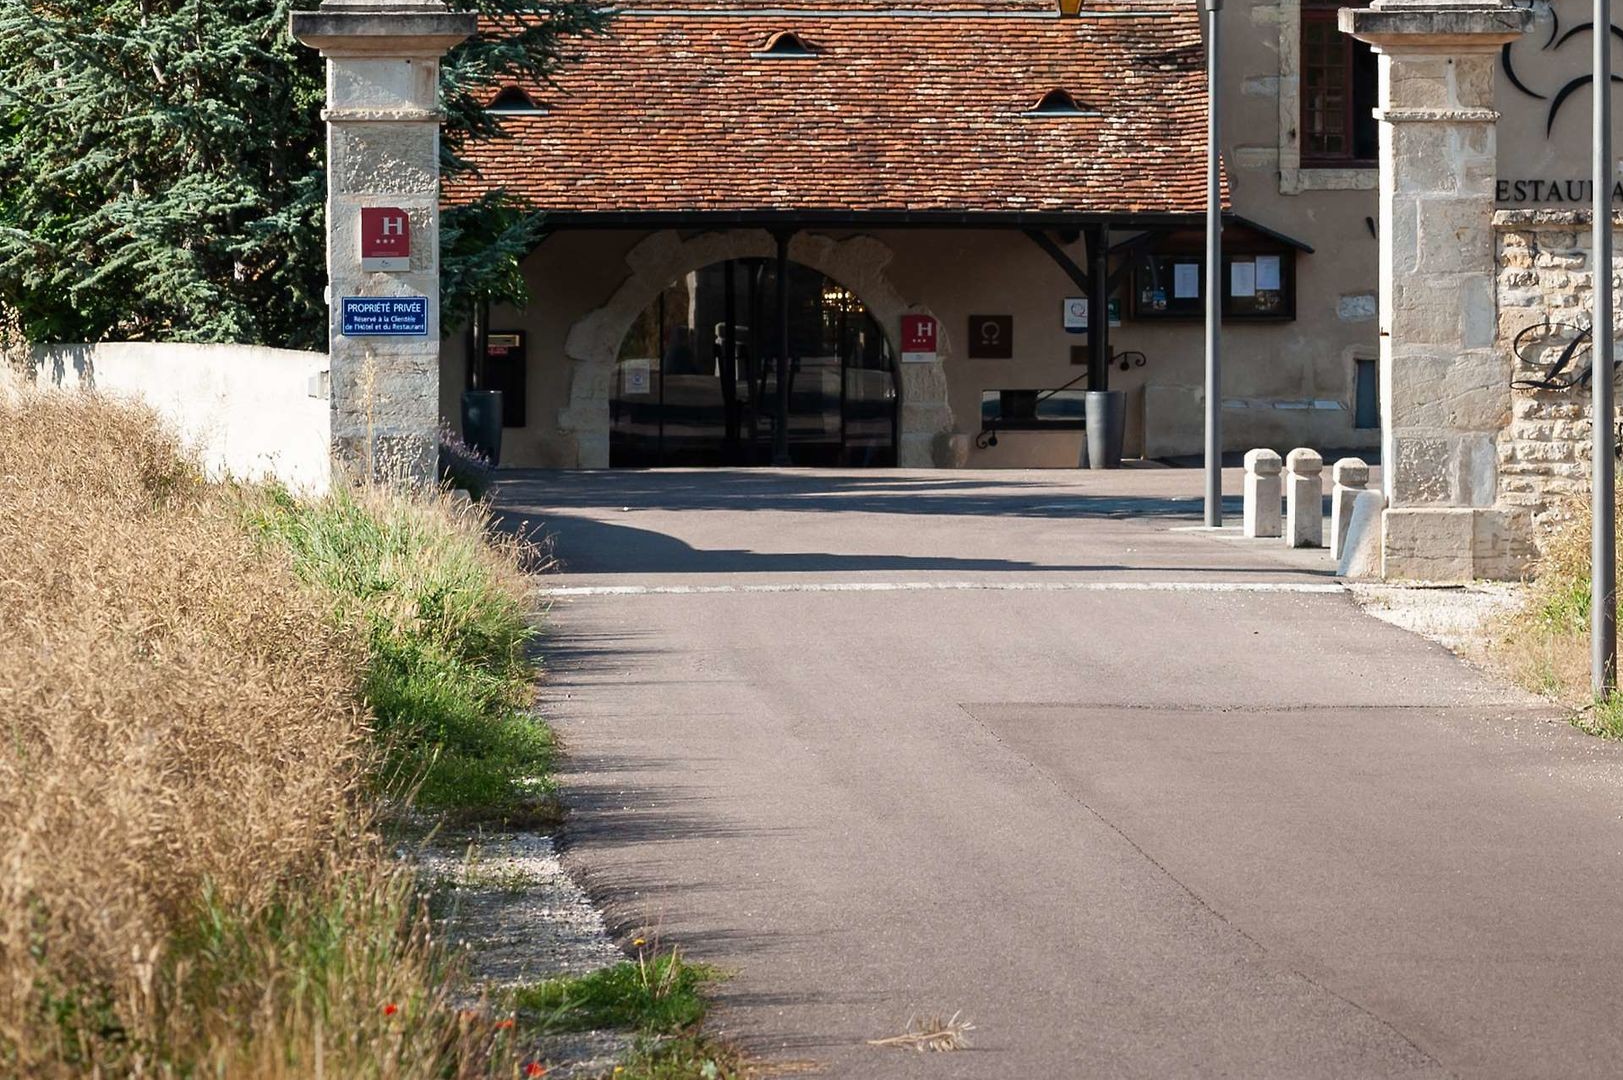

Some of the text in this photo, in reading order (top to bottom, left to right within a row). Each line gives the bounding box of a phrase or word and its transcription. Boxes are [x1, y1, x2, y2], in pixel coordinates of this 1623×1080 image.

[382, 216, 403, 236] H
[347, 302, 421, 313] PROPRIÉTÉ PRIVÉE
[917, 322, 932, 337] H
